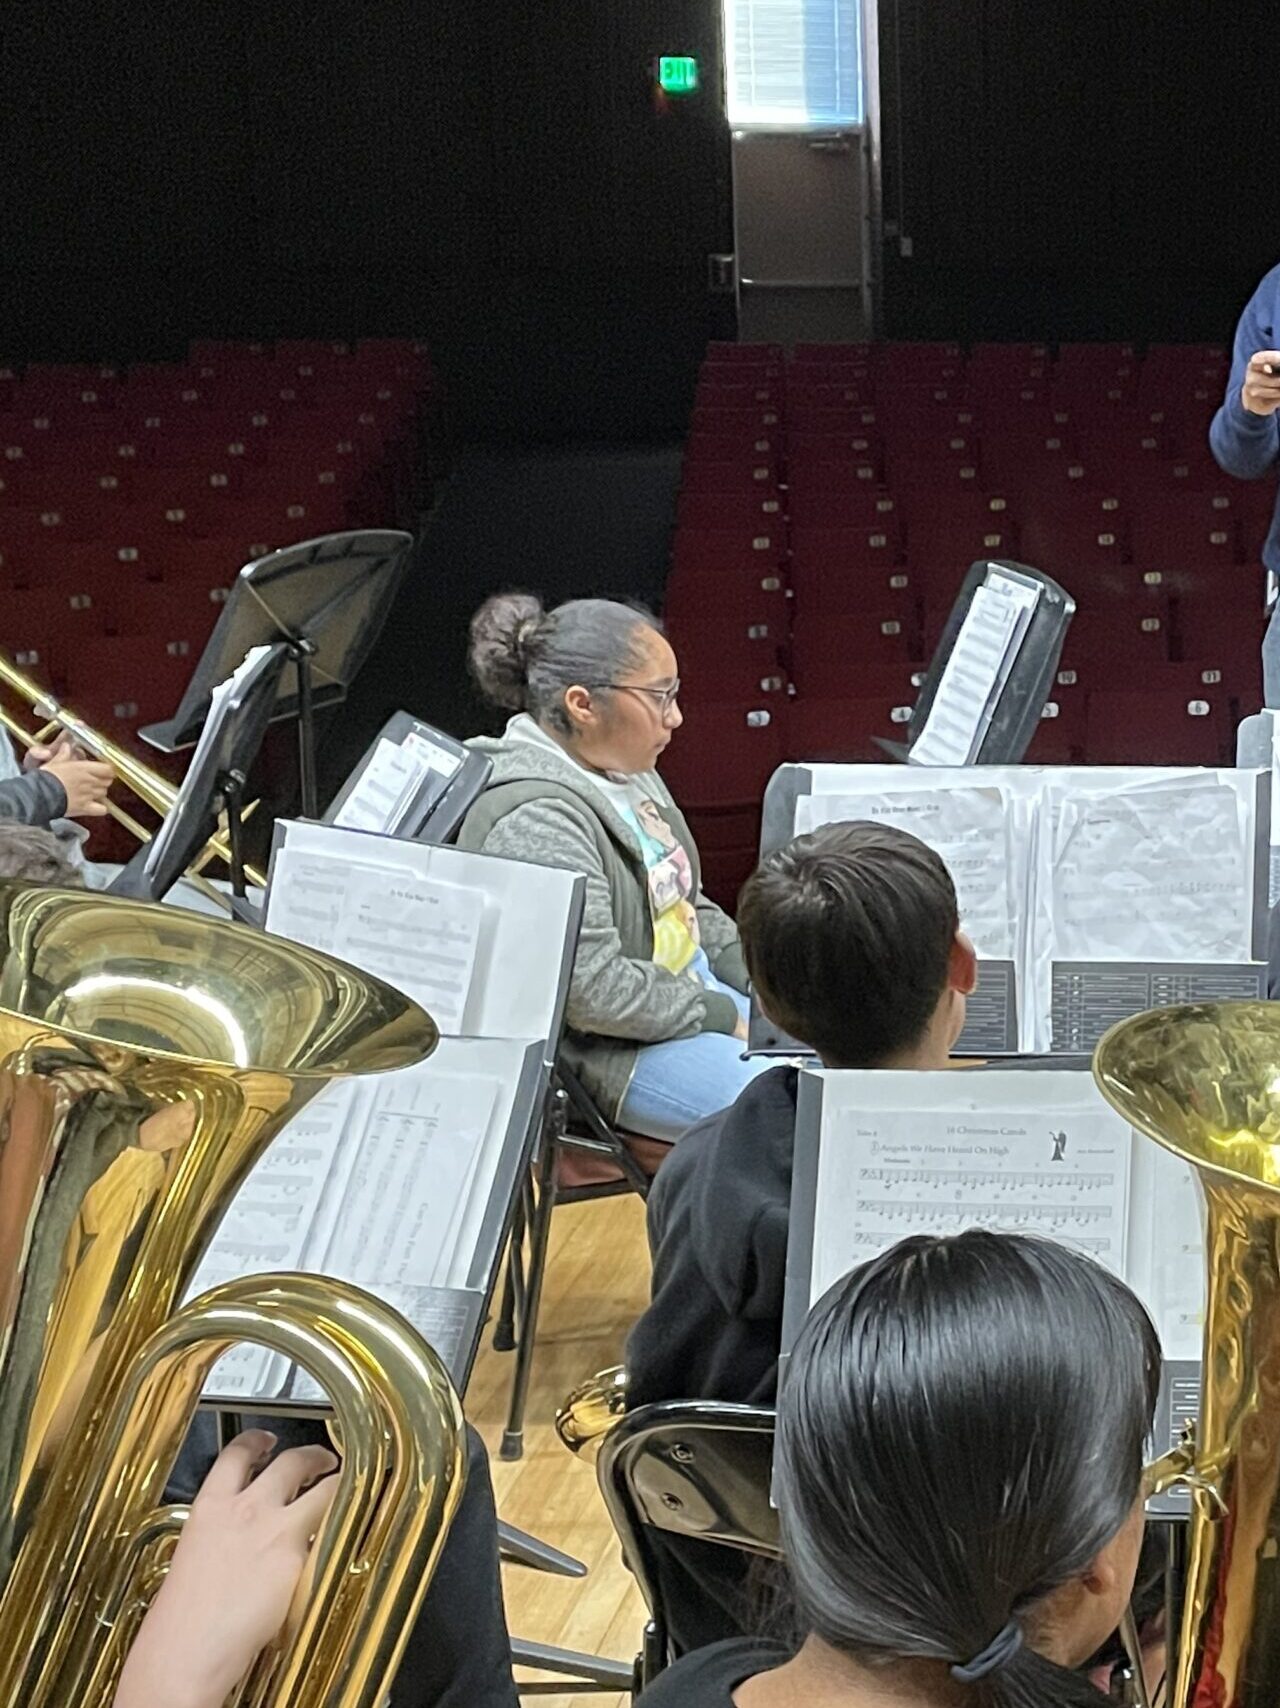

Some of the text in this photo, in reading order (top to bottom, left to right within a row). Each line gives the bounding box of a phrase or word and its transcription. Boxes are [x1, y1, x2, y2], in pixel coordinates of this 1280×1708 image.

[880, 1144, 908, 1153] Angels
[910, 1144, 923, 1152] We
[924, 1145, 946, 1153] Have
[948, 1145, 973, 1154] Heard
[974, 1146, 988, 1154] On
[989, 1146, 1009, 1156] High
